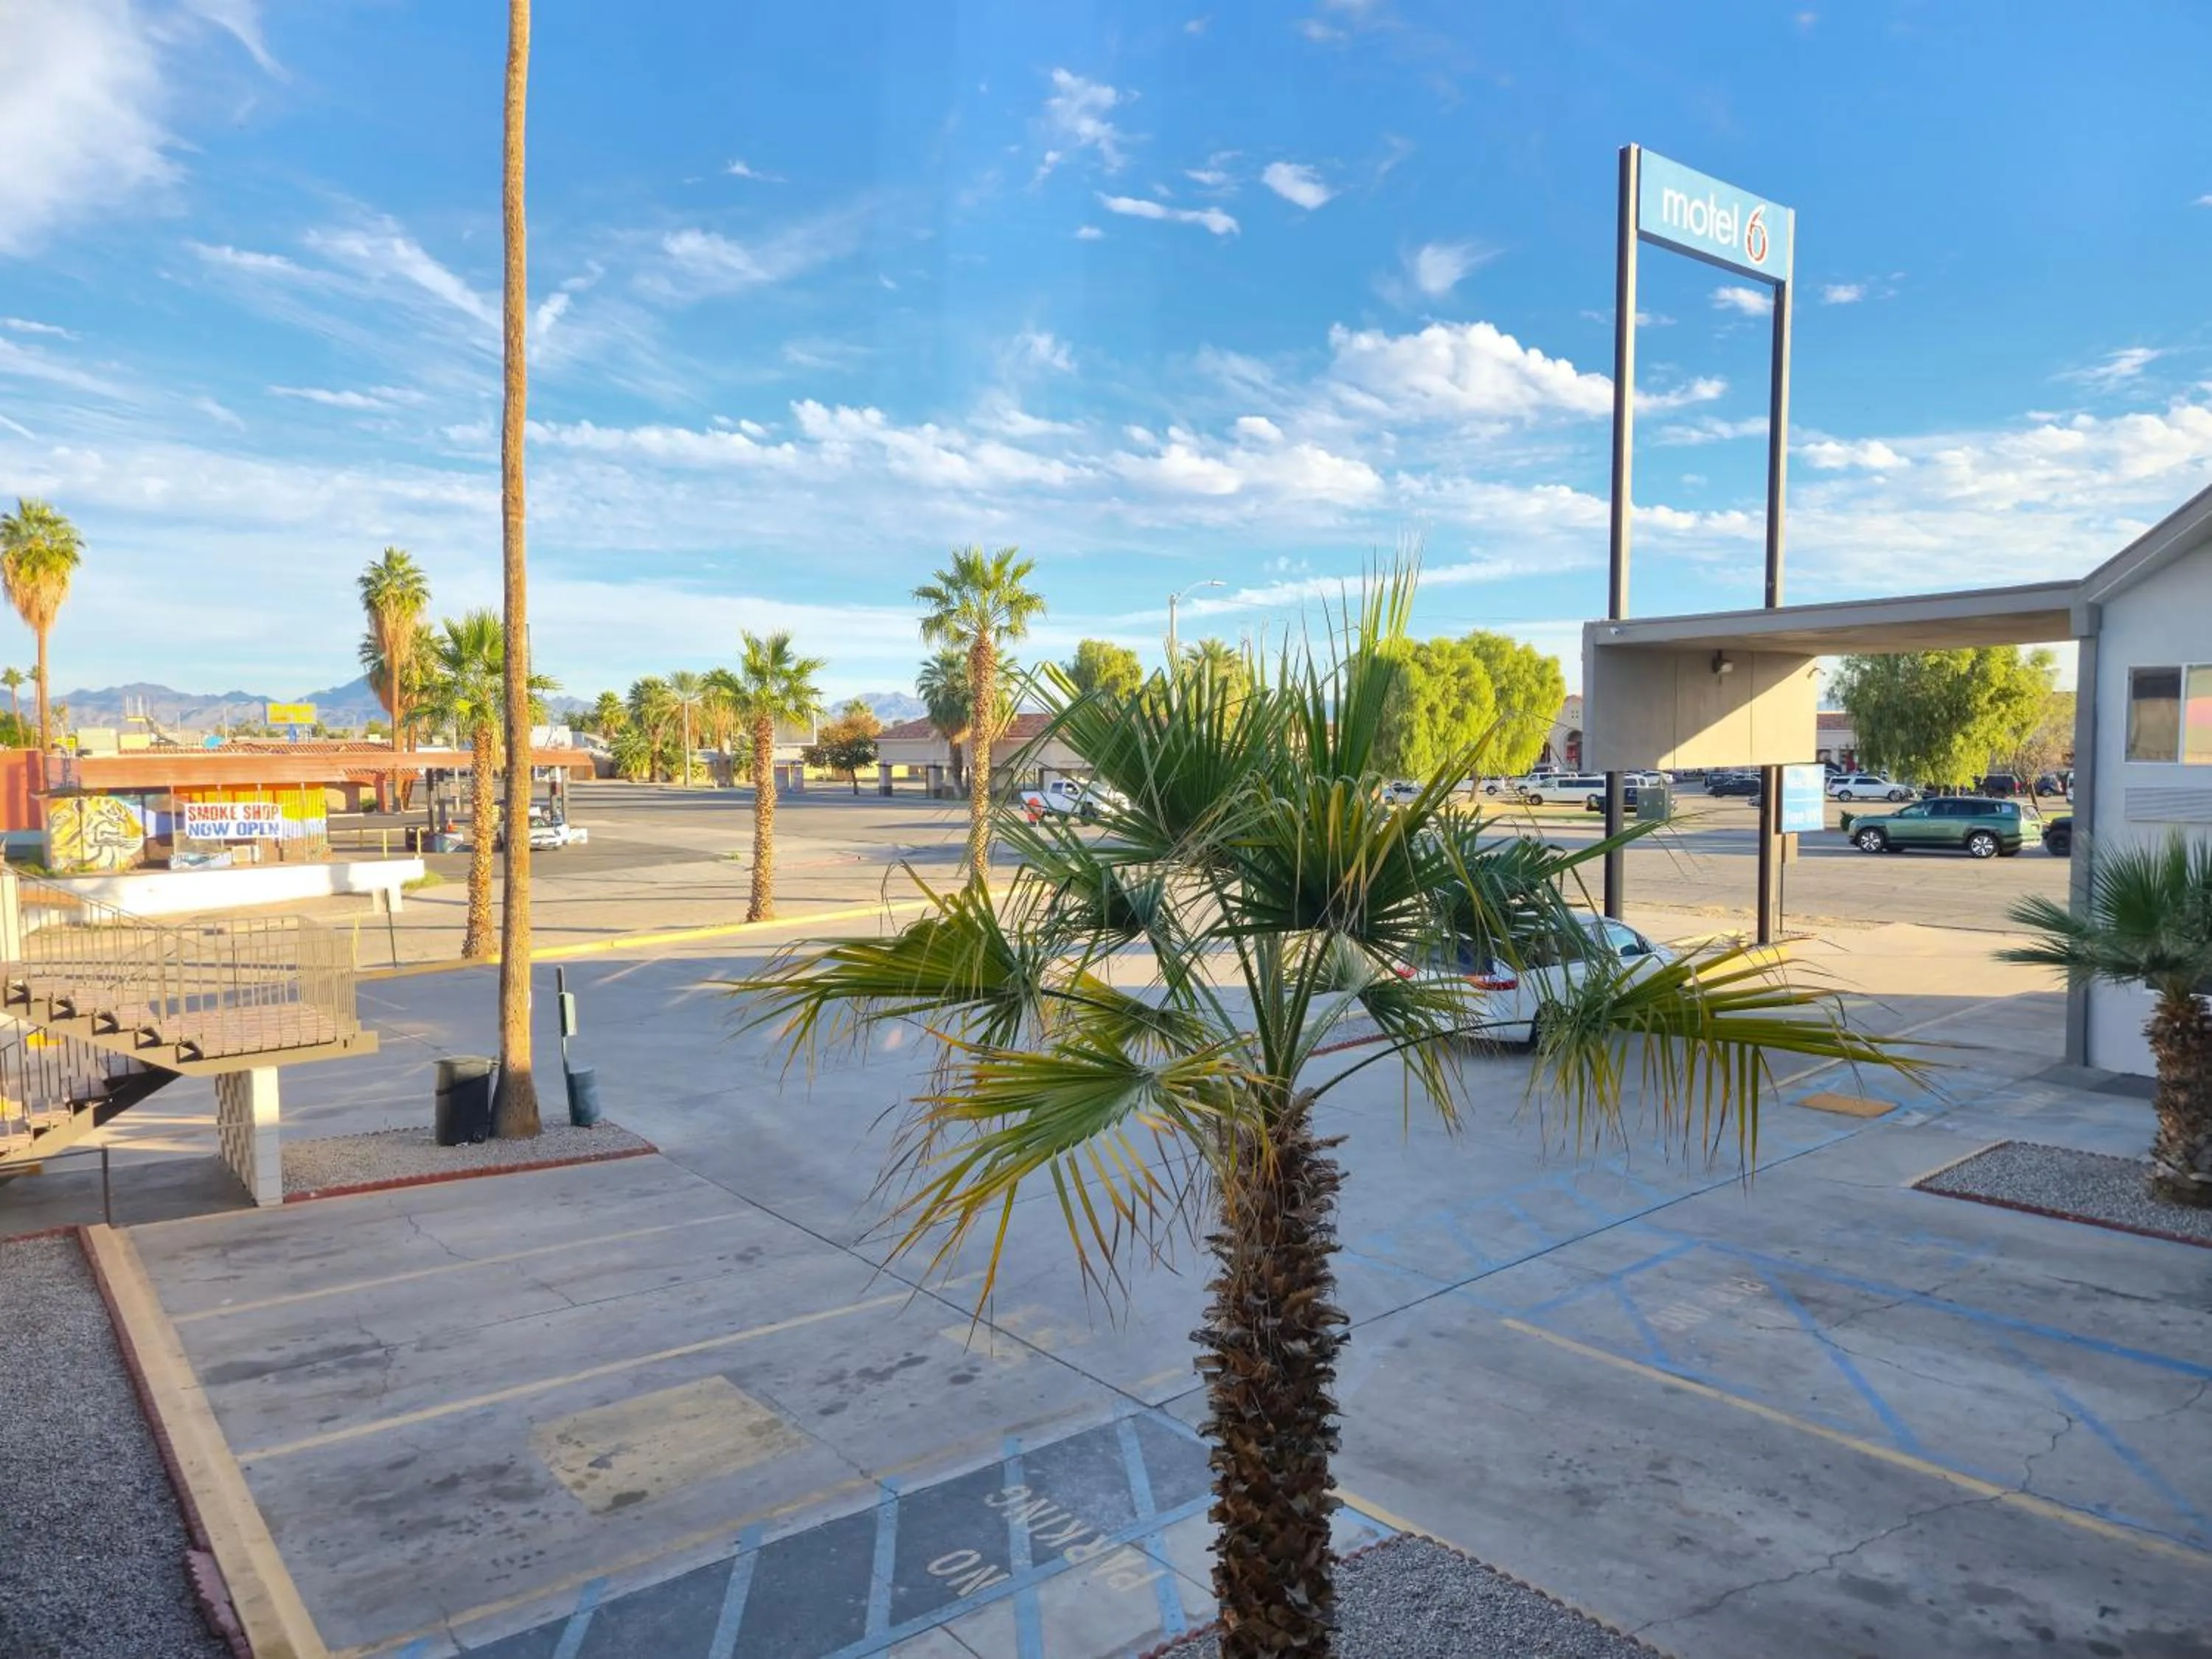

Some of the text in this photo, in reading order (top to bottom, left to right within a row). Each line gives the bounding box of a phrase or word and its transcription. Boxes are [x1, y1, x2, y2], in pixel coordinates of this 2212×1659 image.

[1663, 188, 1768, 265] motel 6
[188, 805, 279, 821] SMOKE SHOP
[189, 821, 279, 835] NOW OPEN
[984, 1485, 1166, 1592] PARKING
[927, 1549, 1011, 1596] NO
